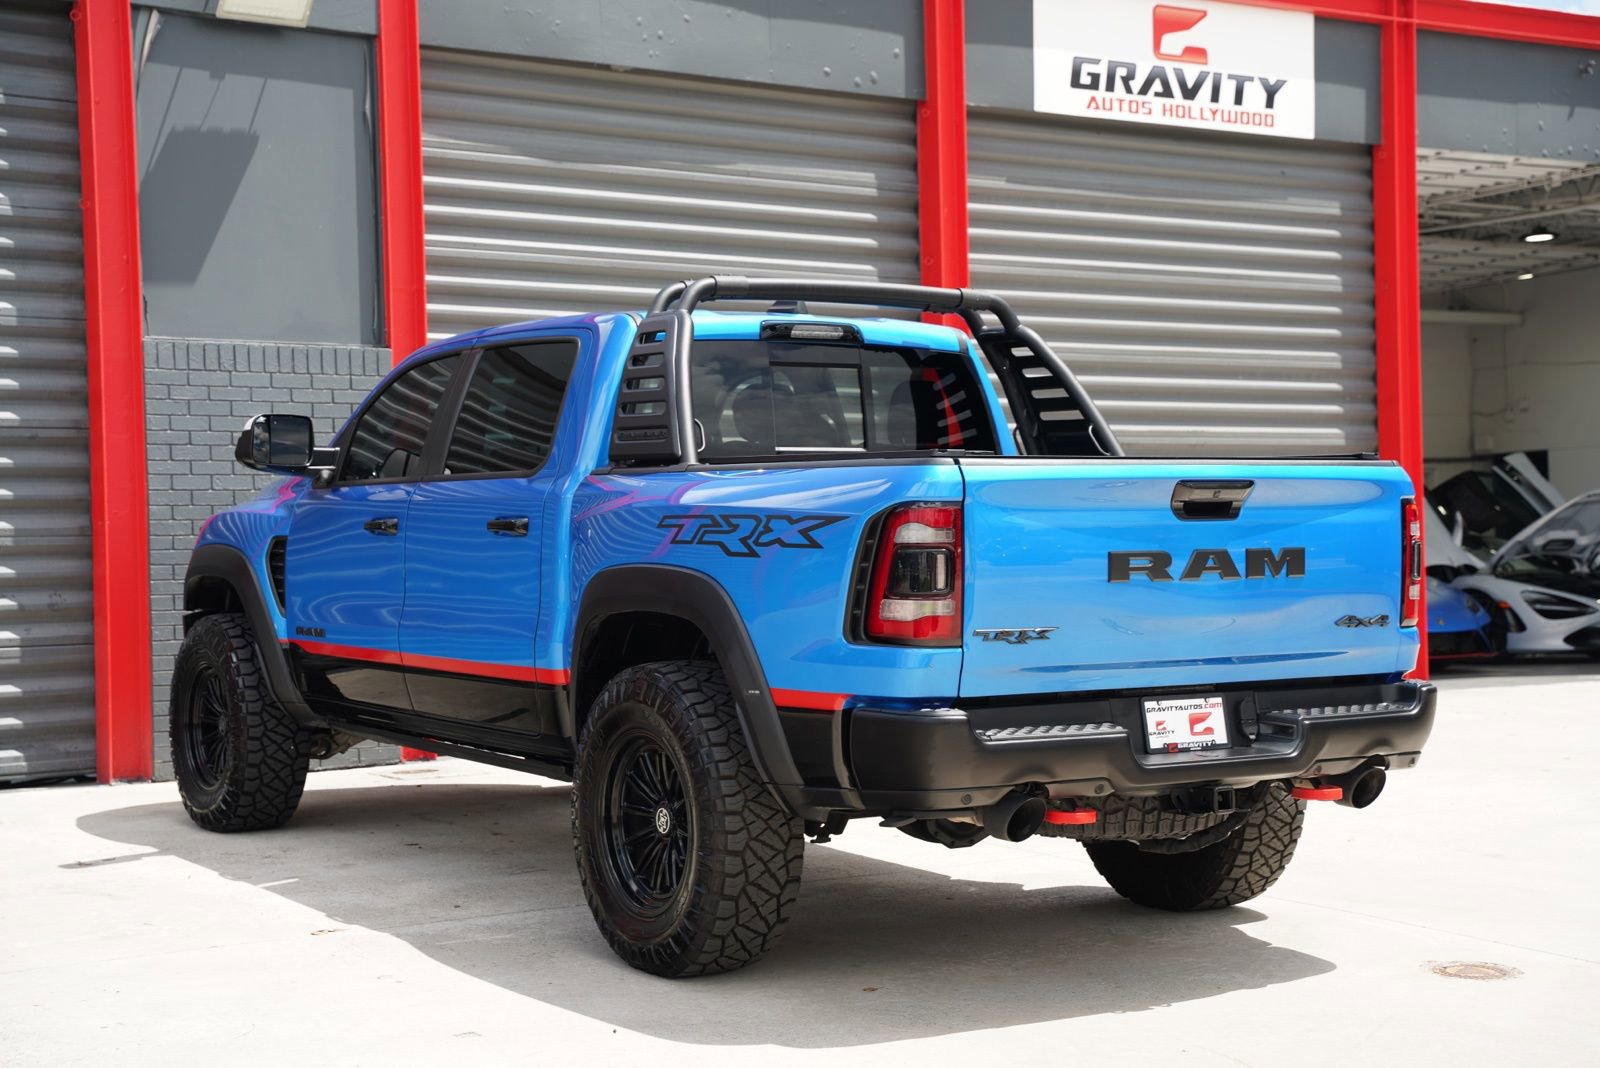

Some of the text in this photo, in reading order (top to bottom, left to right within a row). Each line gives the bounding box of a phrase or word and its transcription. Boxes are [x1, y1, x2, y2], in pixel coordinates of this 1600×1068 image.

[1070, 56, 1287, 109] GRAVITY
[1086, 96, 1274, 127] AUTOS HOLLYWOOD
[656, 514, 851, 558] TRX
[1108, 547, 1305, 583] RAM
[972, 627, 1060, 645] TRX
